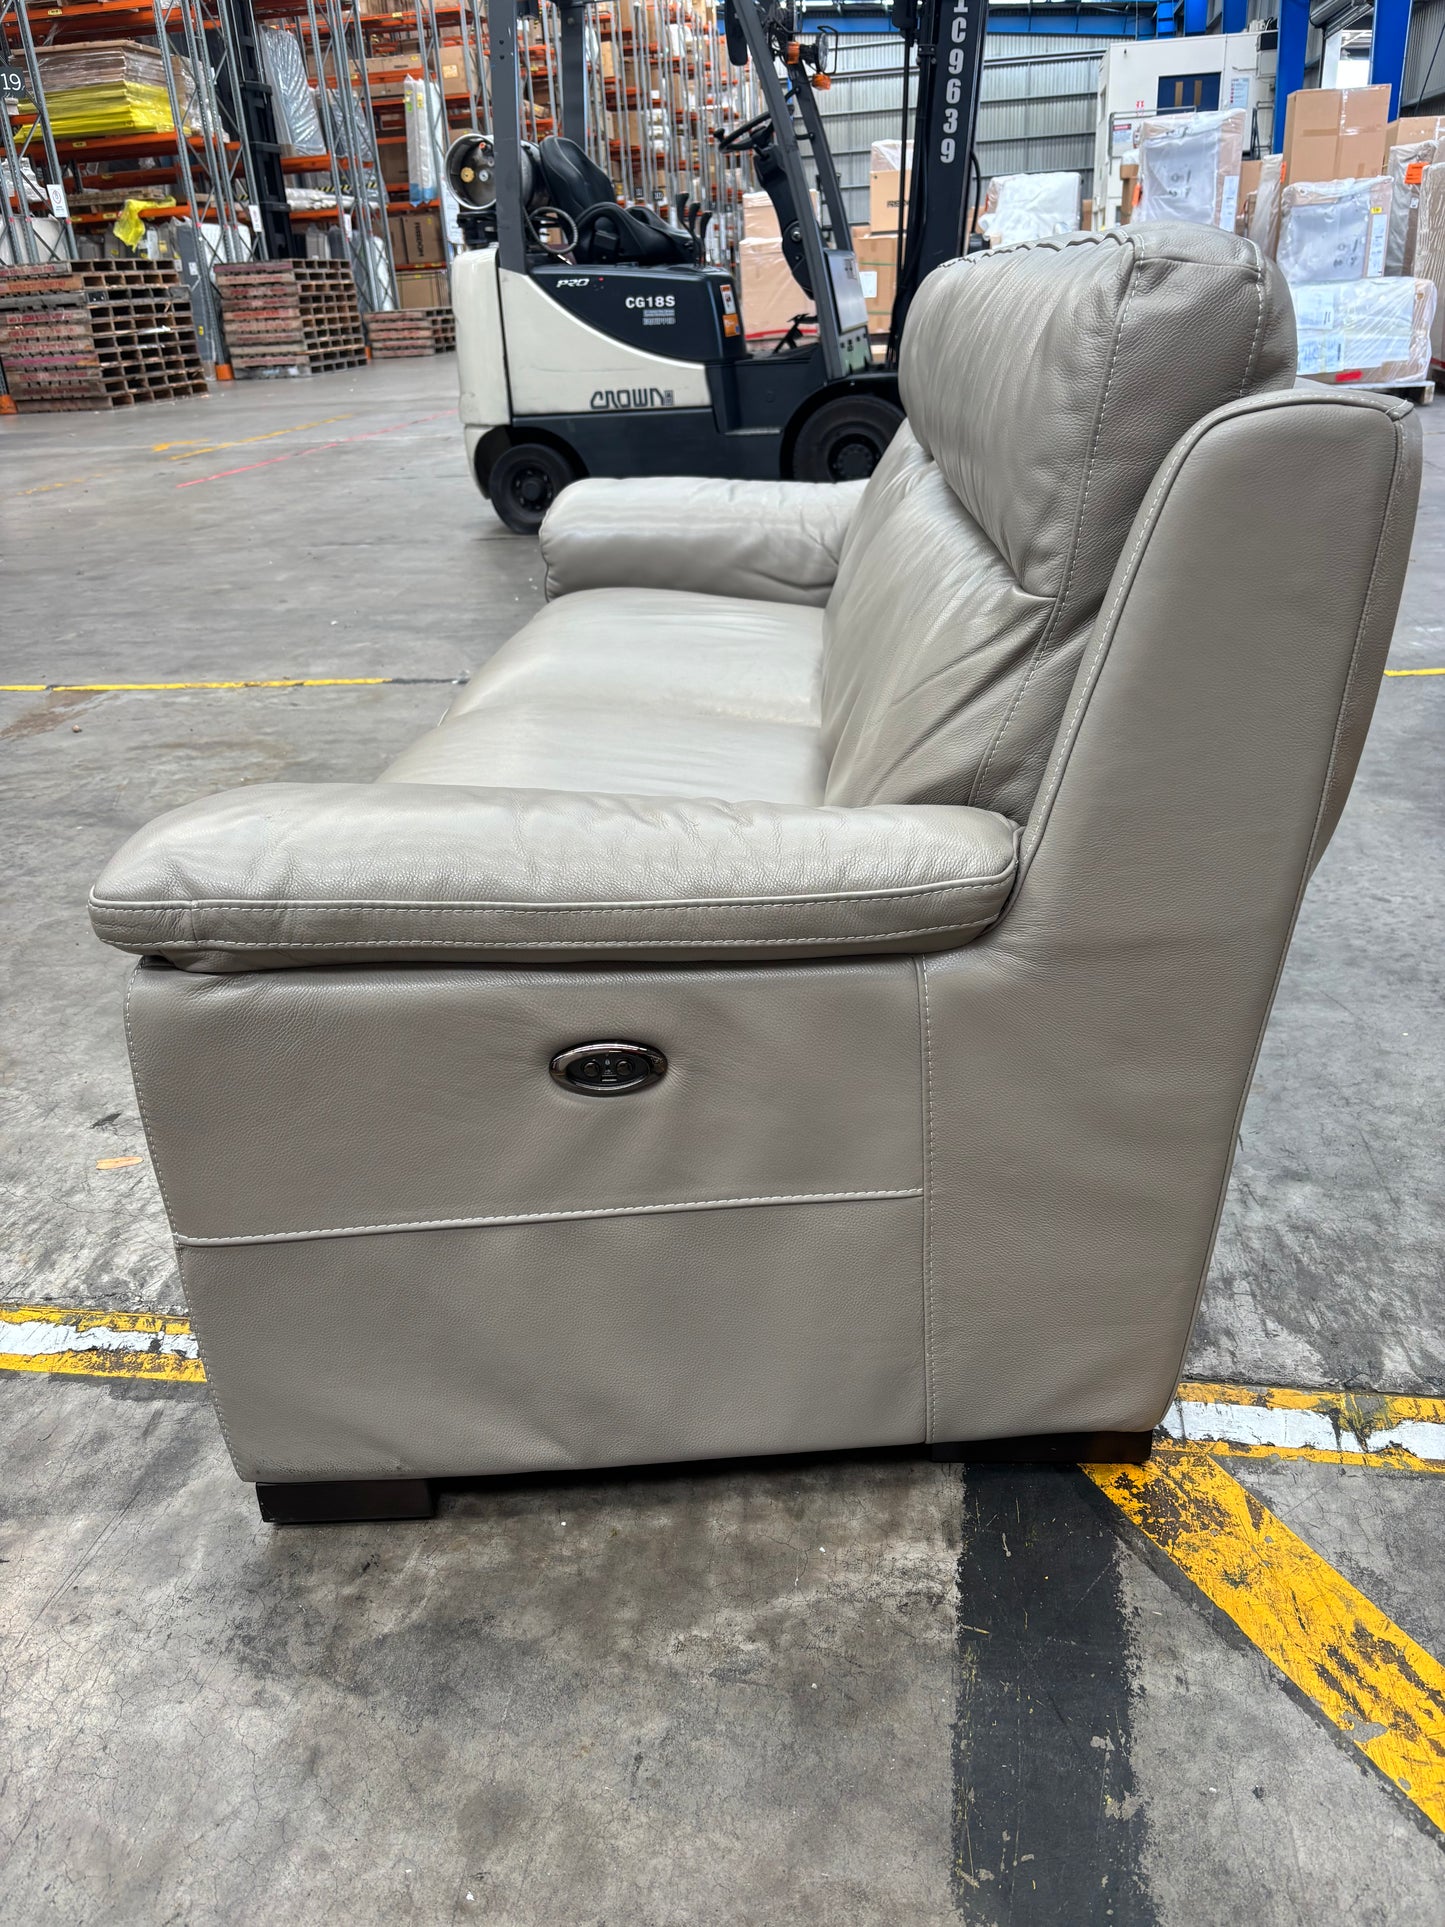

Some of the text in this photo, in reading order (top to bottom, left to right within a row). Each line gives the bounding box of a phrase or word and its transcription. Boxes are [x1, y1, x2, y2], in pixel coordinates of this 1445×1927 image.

[0, 73, 21, 91] 19
[556, 278, 590, 288] PRO
[625, 296, 676, 309] CG18S
[590, 387, 664, 410] CROWN
